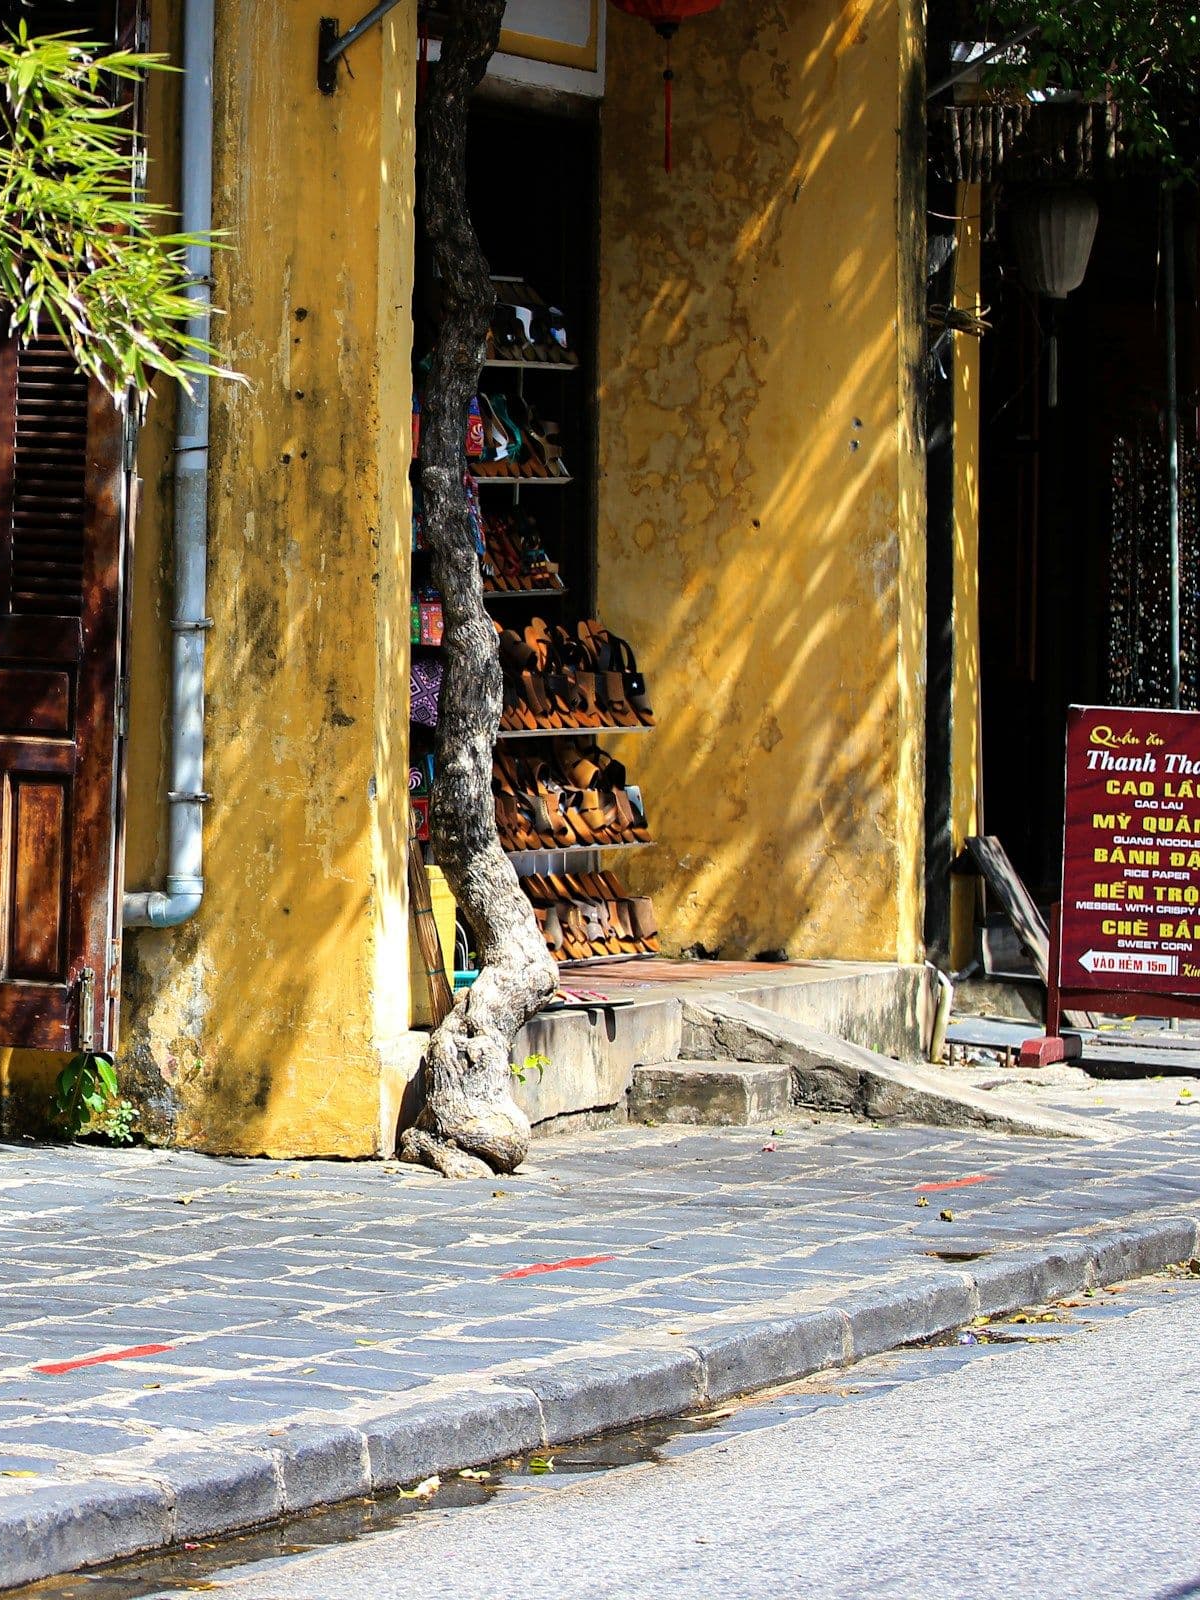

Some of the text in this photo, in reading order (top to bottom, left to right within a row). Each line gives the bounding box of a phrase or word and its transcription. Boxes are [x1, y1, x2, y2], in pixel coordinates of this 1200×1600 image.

[1086, 750, 1157, 773] Thanh
[1106, 779, 1155, 797] CAO
[1134, 800, 1184, 810] CAO LAU
[1094, 847, 1160, 866] BÁNH
[1124, 869, 1191, 880] RICE PAPER
[1094, 881, 1144, 900] HẾN
[1125, 903, 1153, 913] WITH
[1156, 904, 1195, 915] CRISPY
[1102, 919, 1148, 937] CHÈ
[1117, 939, 1193, 951] SWEET CORN
[1093, 955, 1115, 969] VÀO
[1146, 960, 1167, 973] 15m
